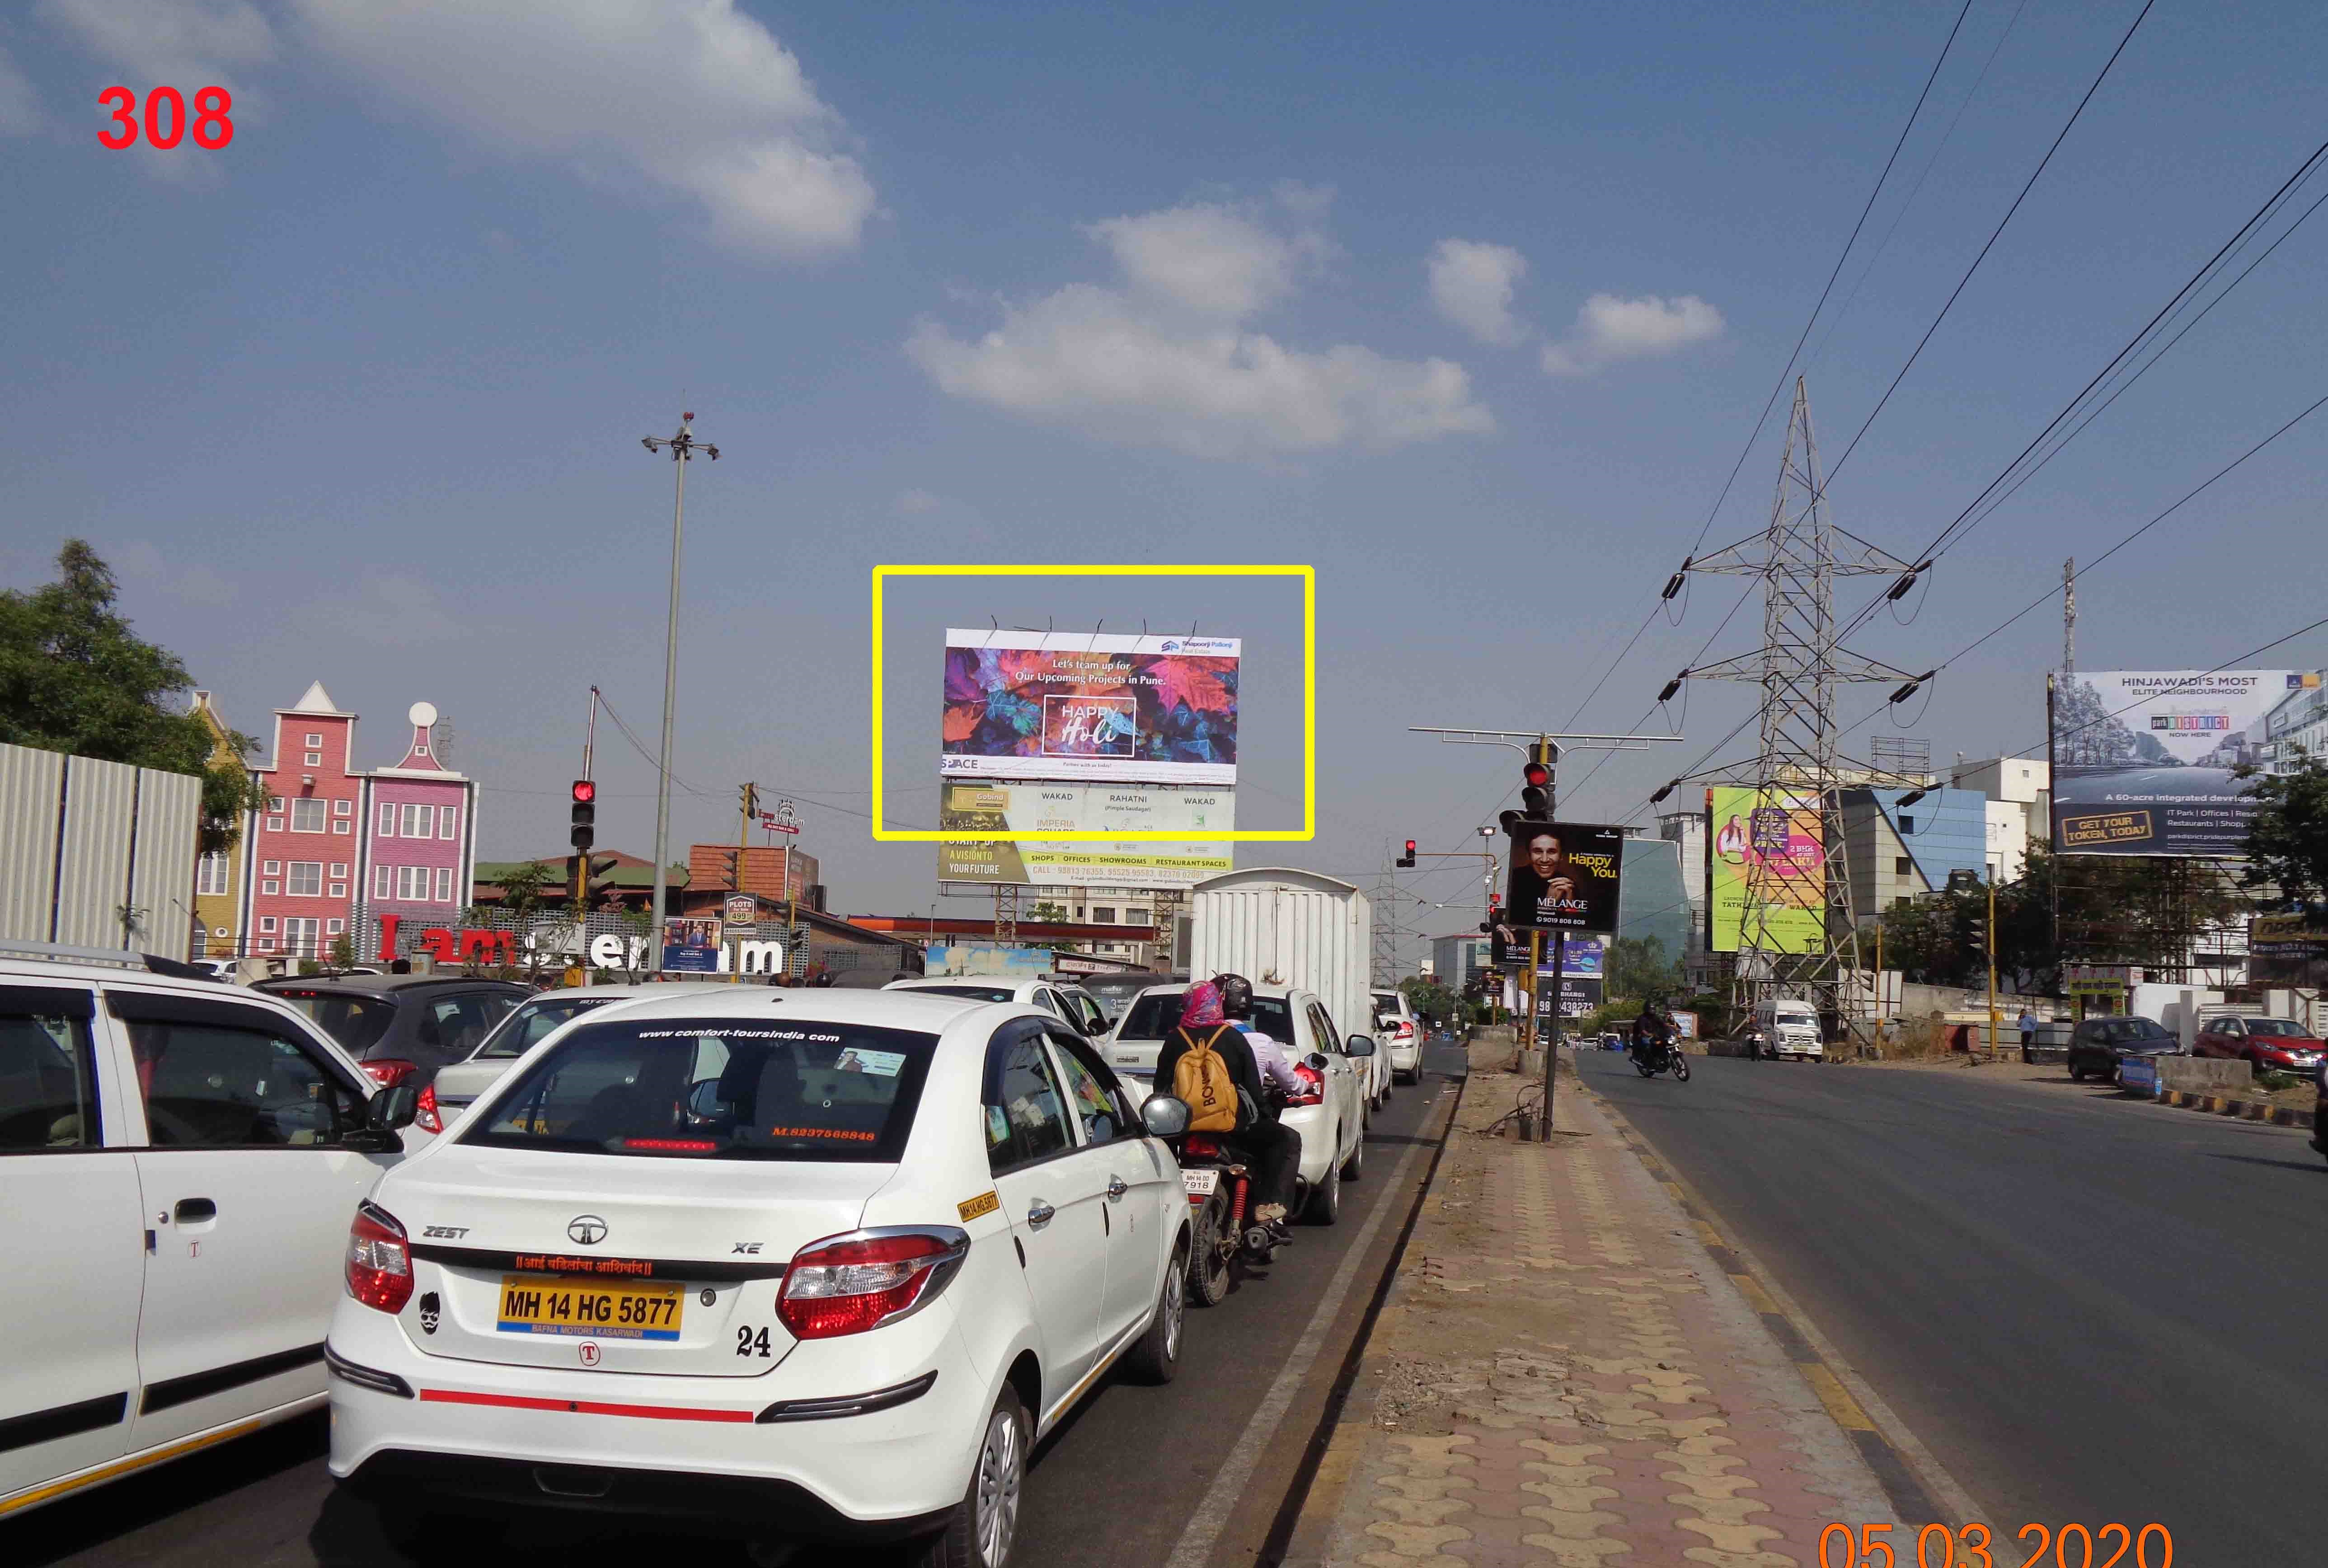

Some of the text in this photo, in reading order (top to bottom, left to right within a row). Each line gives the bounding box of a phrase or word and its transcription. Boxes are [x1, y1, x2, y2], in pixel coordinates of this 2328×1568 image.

[1076, 660, 1100, 670] team
[1103, 663, 1113, 672] up
[1015, 672, 1166, 685] Our Upcoming Projects in Pune.
[2122, 677, 2258, 686] HINJAWADI'S MOST
[1062, 705, 1117, 719] HAPPY
[1061, 718, 1116, 745] Holi
[2156, 794, 2207, 804] integrated
[1037, 819, 1075, 828] IMPERIA
[2079, 817, 2132, 829] GET YOUR
[2110, 825, 2146, 837] TODAY
[950, 850, 992, 860] A VISION TO
[1569, 853, 1612, 868] Happy
[949, 863, 1000, 874] YOUR FUTURE
[1591, 866, 1617, 878] You.
[1537, 896, 1587, 909] MÉLANGE
[380, 914, 399, 960] I
[1110, 999, 1117, 1009] 3
[423, 1225, 470, 1239] ZEST
[190, 1242, 198, 1258] T
[731, 1242, 765, 1254] XE
[505, 1291, 677, 1325] MH 14 HG 5877
[532, 1325, 643, 1338] BAFNA MOTORS KASARWADI
[737, 1325, 770, 1357] 24
[582, 1346, 595, 1360] T
